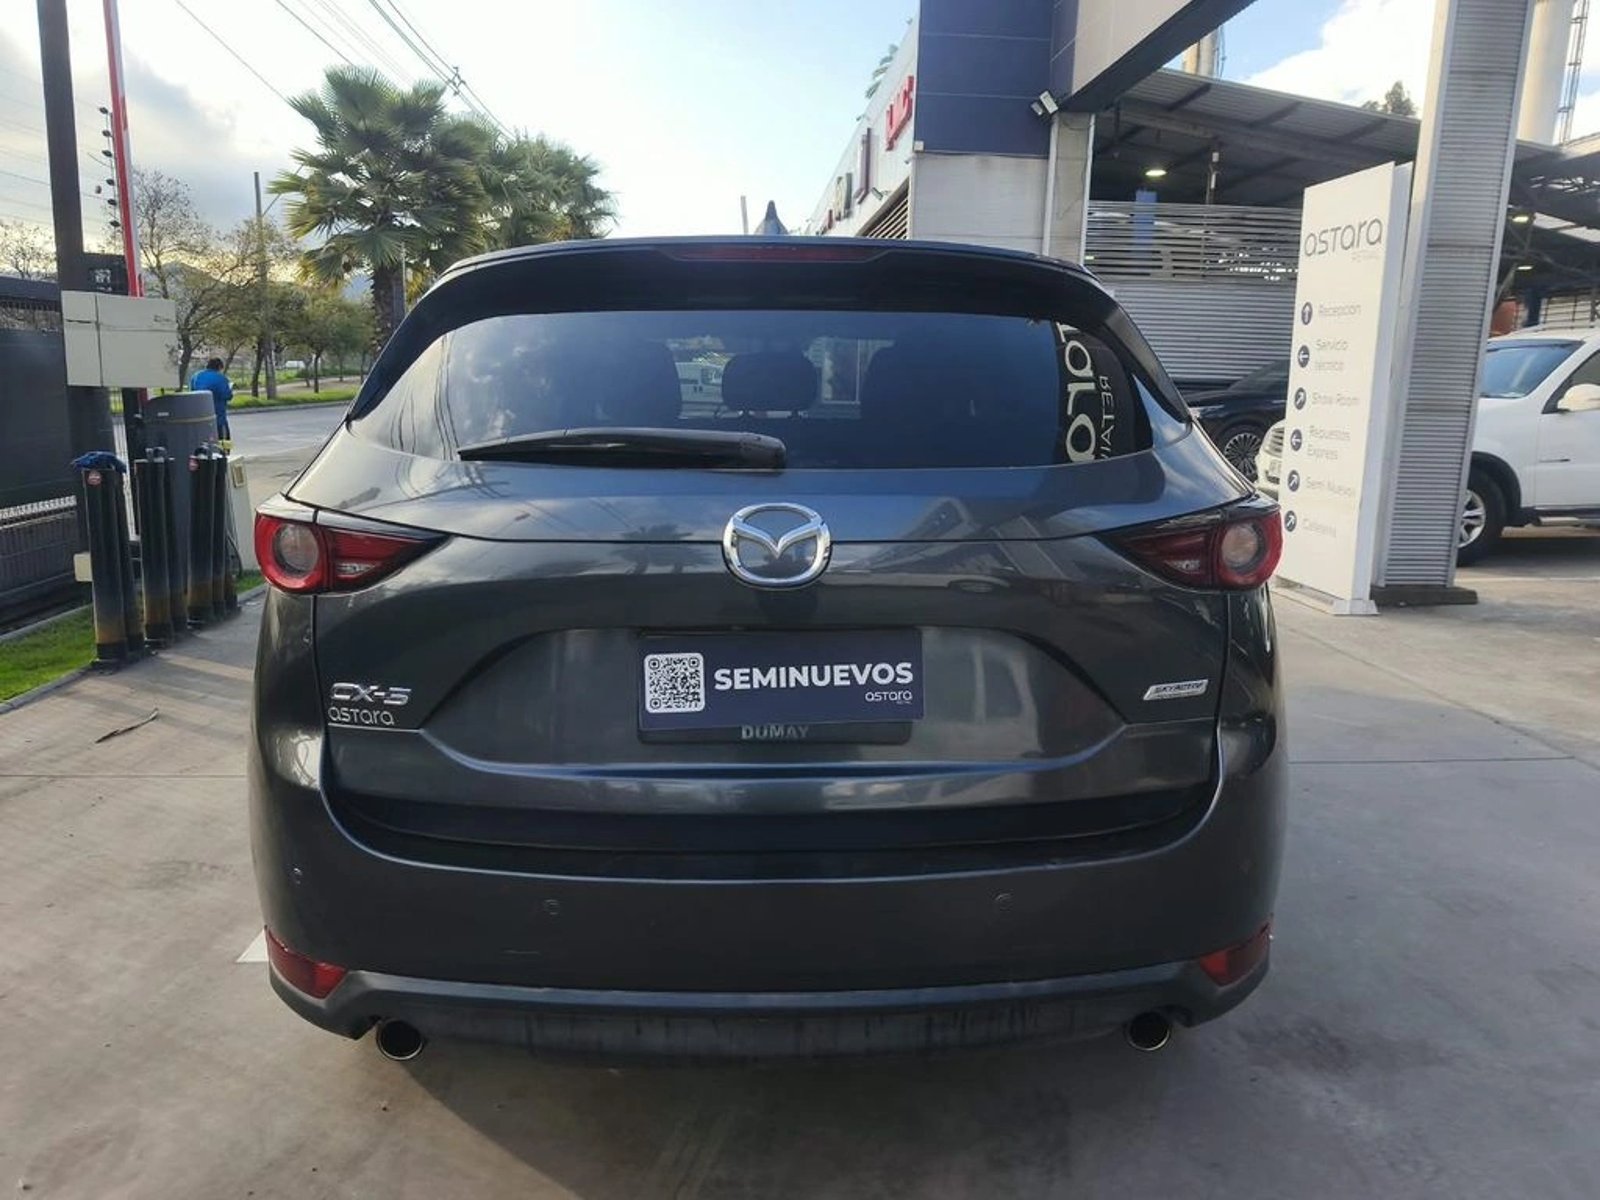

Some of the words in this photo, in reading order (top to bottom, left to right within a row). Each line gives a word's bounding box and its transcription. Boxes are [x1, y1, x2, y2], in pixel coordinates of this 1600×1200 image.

[1304, 218, 1384, 258] astara
[1307, 444, 1339, 461] Express
[714, 662, 914, 691] SEMINUEVOS
[331, 682, 411, 706] CX-5
[865, 690, 913, 703] astara
[327, 706, 394, 726] astara
[741, 723, 809, 740] DUMAY
